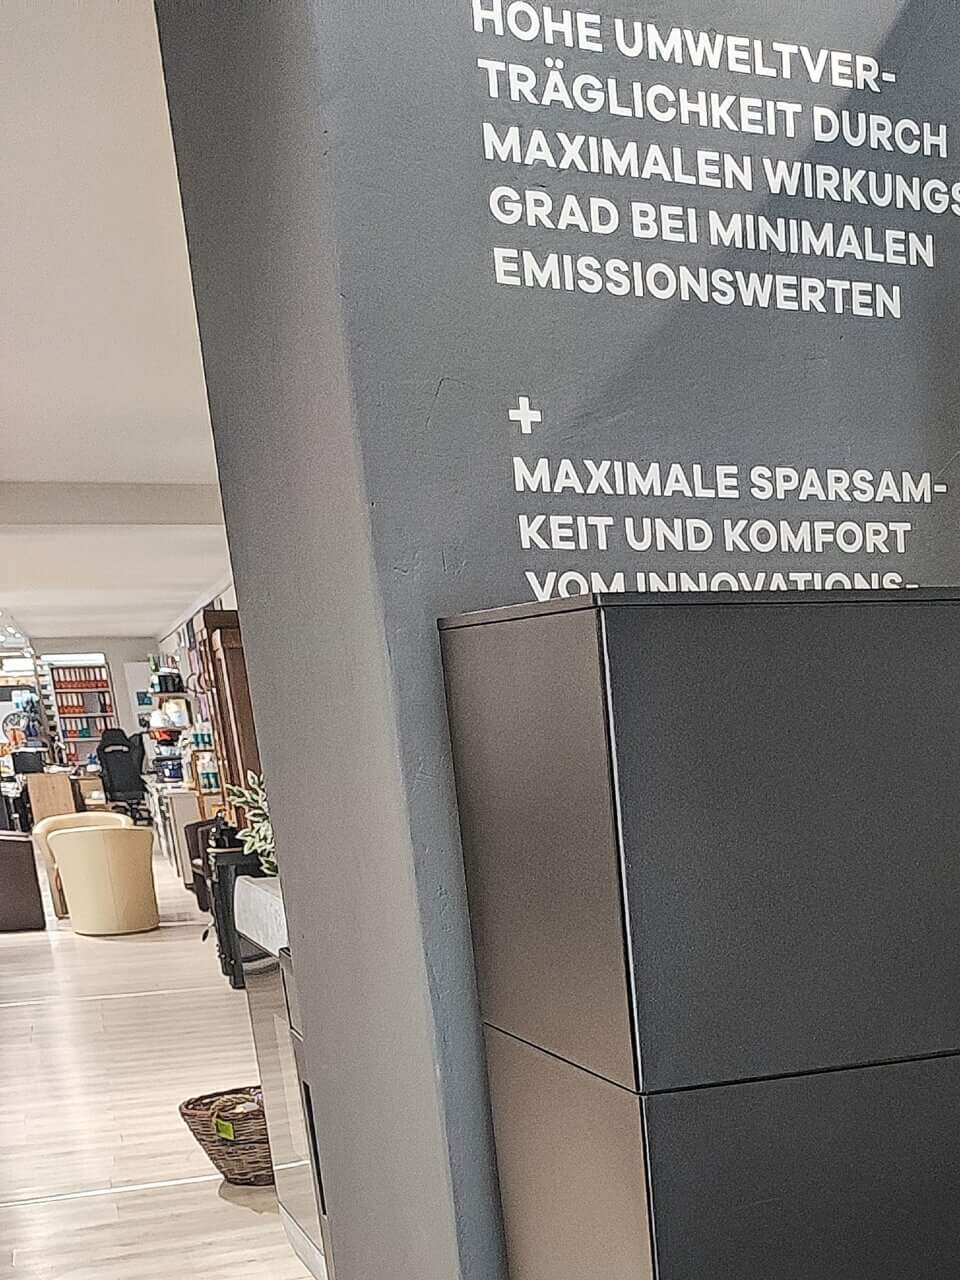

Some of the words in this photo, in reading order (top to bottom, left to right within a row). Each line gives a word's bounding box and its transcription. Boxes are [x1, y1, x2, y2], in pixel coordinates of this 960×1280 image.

[472, 0, 603, 53] HOHE
[614, 17, 897, 92] UMWELTVER-
[477, 57, 803, 138] TRÄGLICHKEIT
[812, 106, 948, 158] DURCH
[482, 122, 752, 191] MAXIMALEN
[489, 186, 619, 234] GRAD
[632, 201, 698, 243] BEI
[709, 210, 934, 268] MINIMALEN
[493, 247, 902, 319] EMISSIONSWERTEN
[513, 456, 739, 499] MAXIMALE
[749, 467, 948, 503] SPARSAM-
[518, 515, 614, 550] KEIT
[625, 517, 713, 552] UND
[724, 520, 912, 554] KOMFORT
[525, 570, 624, 601] VOM
[637, 570, 919, 593] INNOVATIONS-
